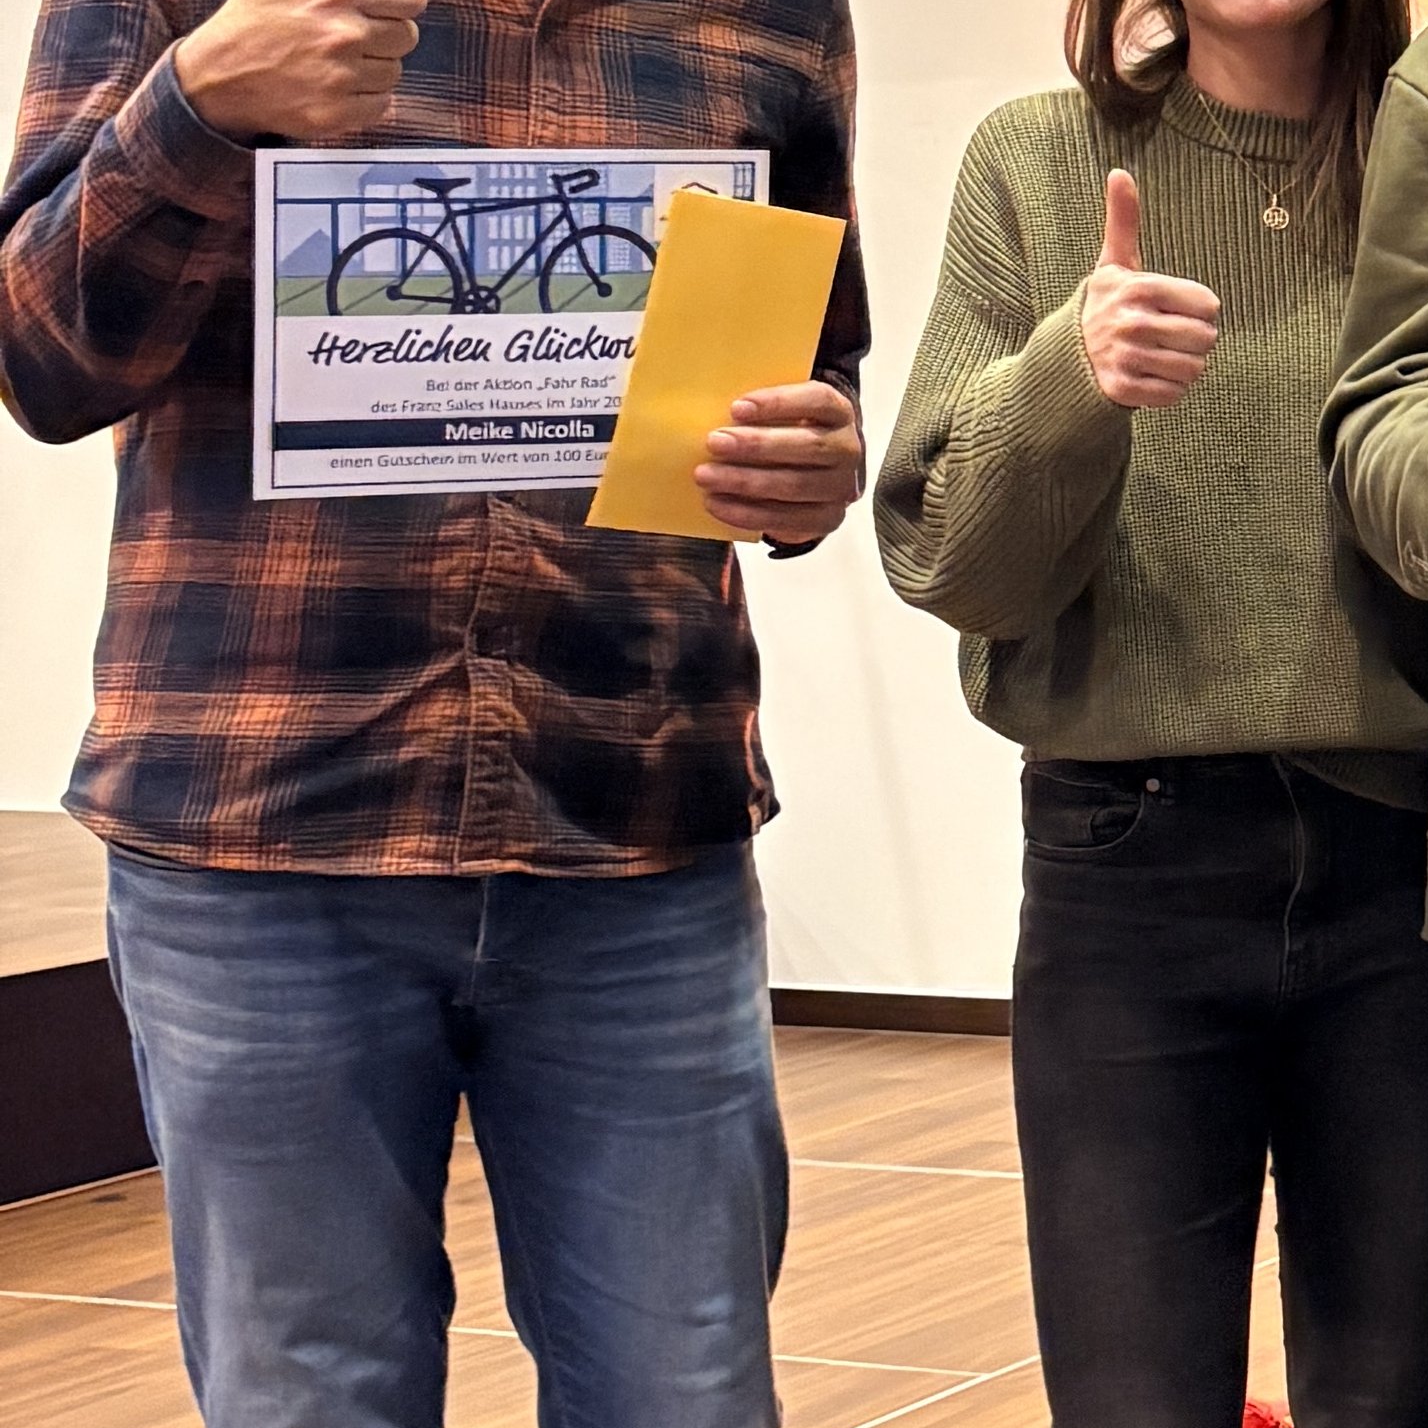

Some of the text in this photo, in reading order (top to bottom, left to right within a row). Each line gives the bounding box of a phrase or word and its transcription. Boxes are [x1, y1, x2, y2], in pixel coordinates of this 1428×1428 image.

[307, 324, 637, 366] Herzlichen Glückwu
[425, 379, 449, 392] Bei
[454, 378, 479, 391] der
[483, 378, 533, 391] Aktion
[371, 400, 397, 413] des
[401, 399, 441, 413] Franz
[446, 398, 484, 411] Sales
[546, 397, 565, 408] im
[569, 396, 600, 409] Jahr
[604, 396, 622, 408] 20
[445, 420, 595, 441] Meike Nicolla
[330, 448, 609, 469] einen Gutschein im Wert von 100 Eur
